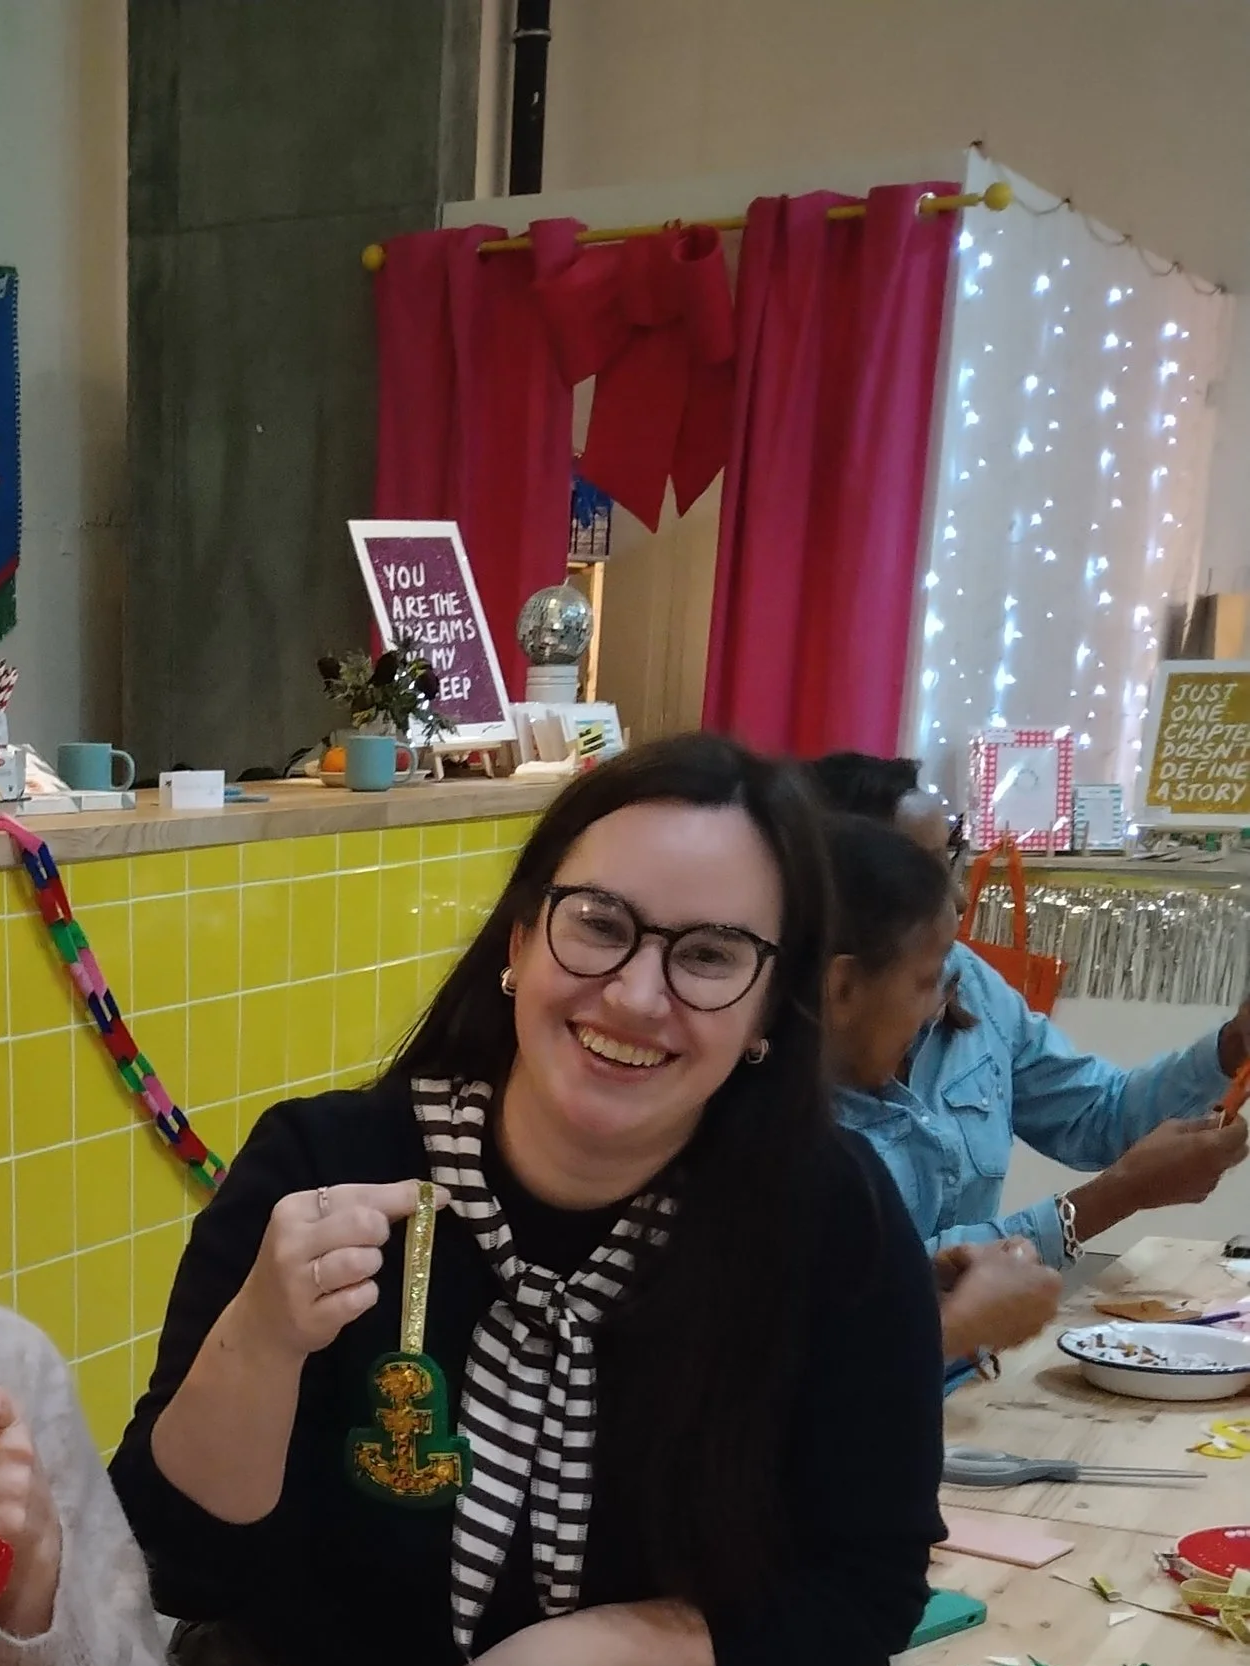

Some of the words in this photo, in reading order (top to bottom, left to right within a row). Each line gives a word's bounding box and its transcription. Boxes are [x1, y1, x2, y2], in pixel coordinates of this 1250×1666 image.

[383, 562, 426, 590] YOU
[392, 596, 430, 619] ARE
[433, 592, 462, 616] THE
[432, 646, 456, 670] MY
[440, 677, 472, 700] EEP
[1172, 683, 1238, 702] JUST
[1171, 704, 1226, 721] ONE
[1164, 724, 1250, 742] CHAPTE
[1162, 742, 1250, 759] DOESN'T
[1160, 761, 1250, 779] DEFINE
